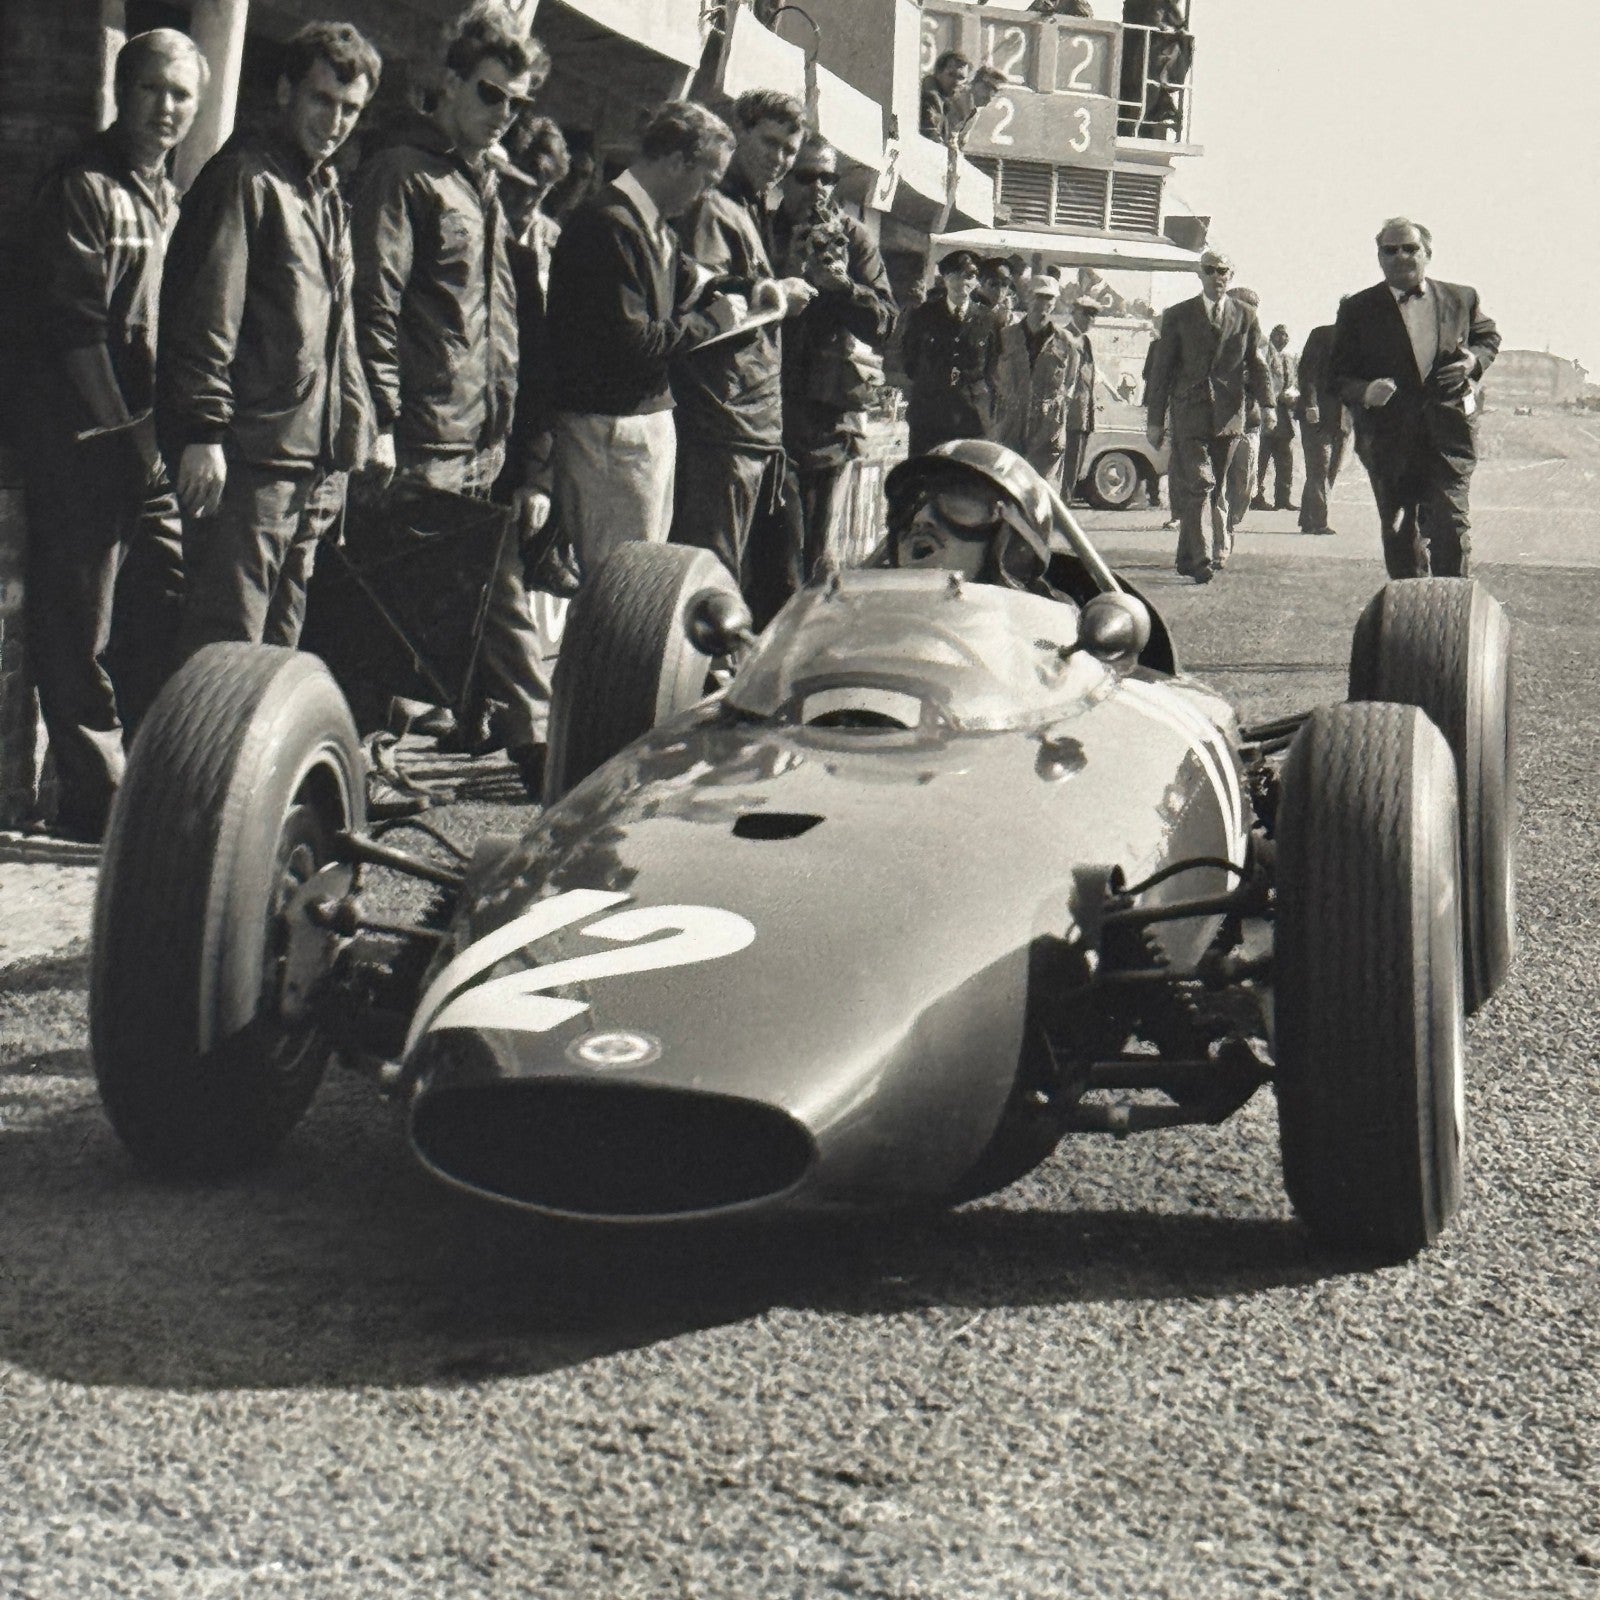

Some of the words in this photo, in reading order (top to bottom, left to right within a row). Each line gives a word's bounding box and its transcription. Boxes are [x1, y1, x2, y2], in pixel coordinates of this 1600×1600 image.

[986, 24, 1026, 84] 12
[1068, 35, 1095, 90] 2
[990, 97, 1015, 146] 2
[1069, 107, 1092, 152] 3
[401, 888, 757, 1062] 12
